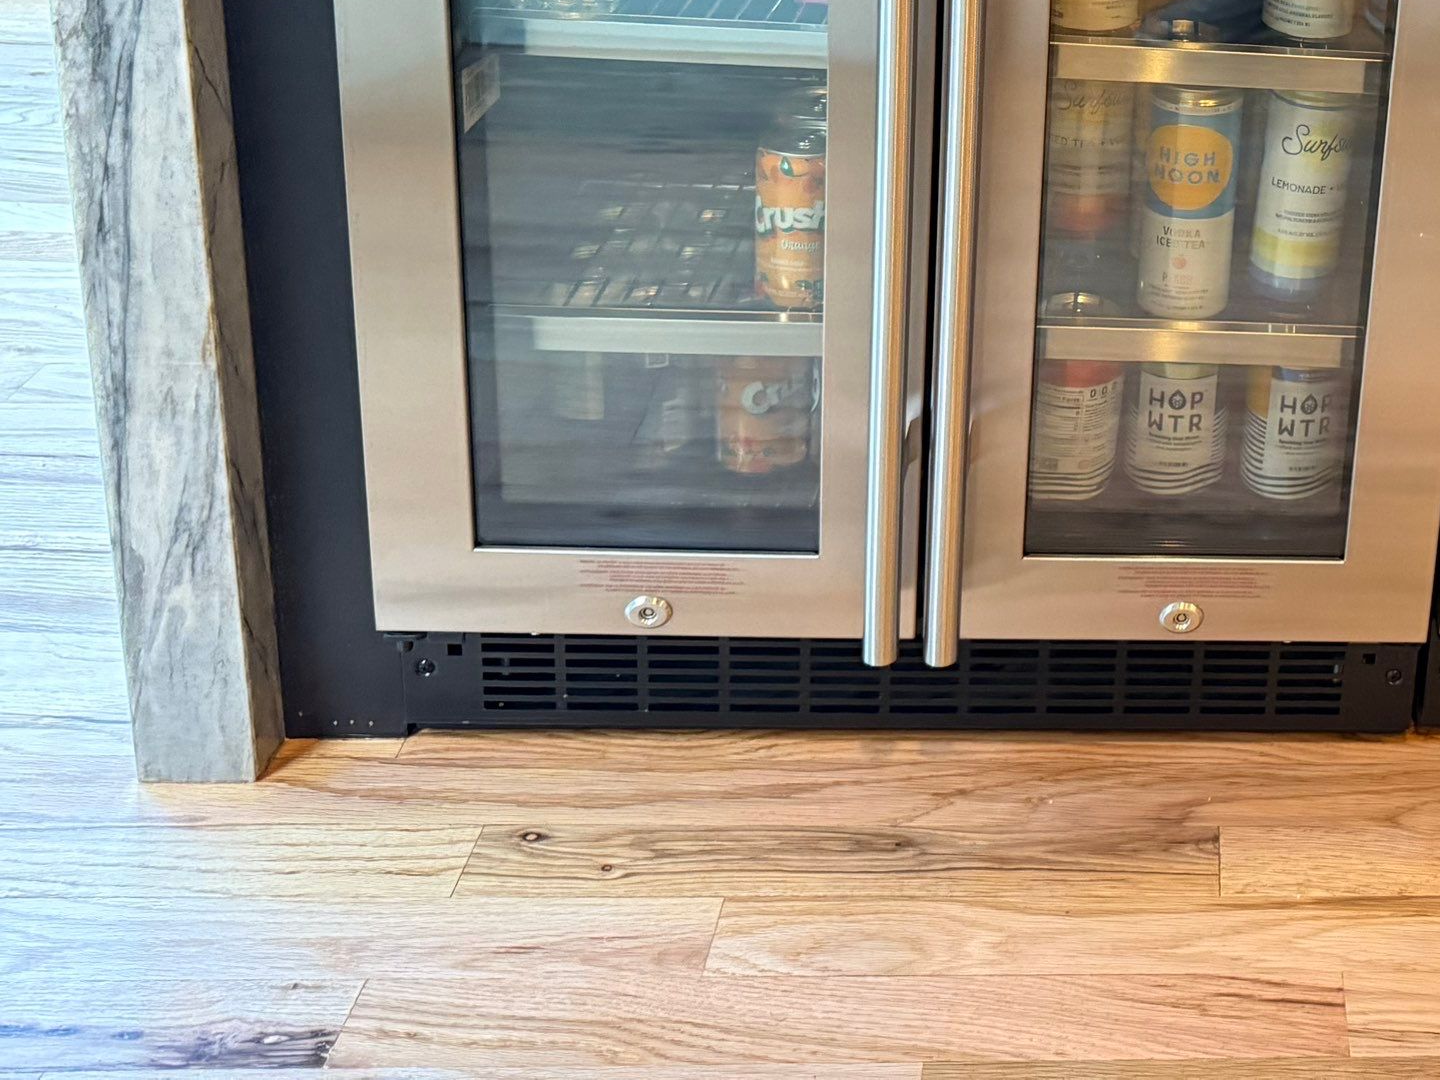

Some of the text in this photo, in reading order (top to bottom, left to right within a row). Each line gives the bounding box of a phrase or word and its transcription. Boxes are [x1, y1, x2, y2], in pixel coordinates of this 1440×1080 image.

[1160, 144, 1217, 168] HIGH
[1154, 164, 1221, 185] NOON
[1271, 176, 1328, 195] LEMONADE
[1148, 387, 1204, 411] HOP
[1147, 409, 1203, 433] WTR
[1278, 416, 1331, 437] WTR
